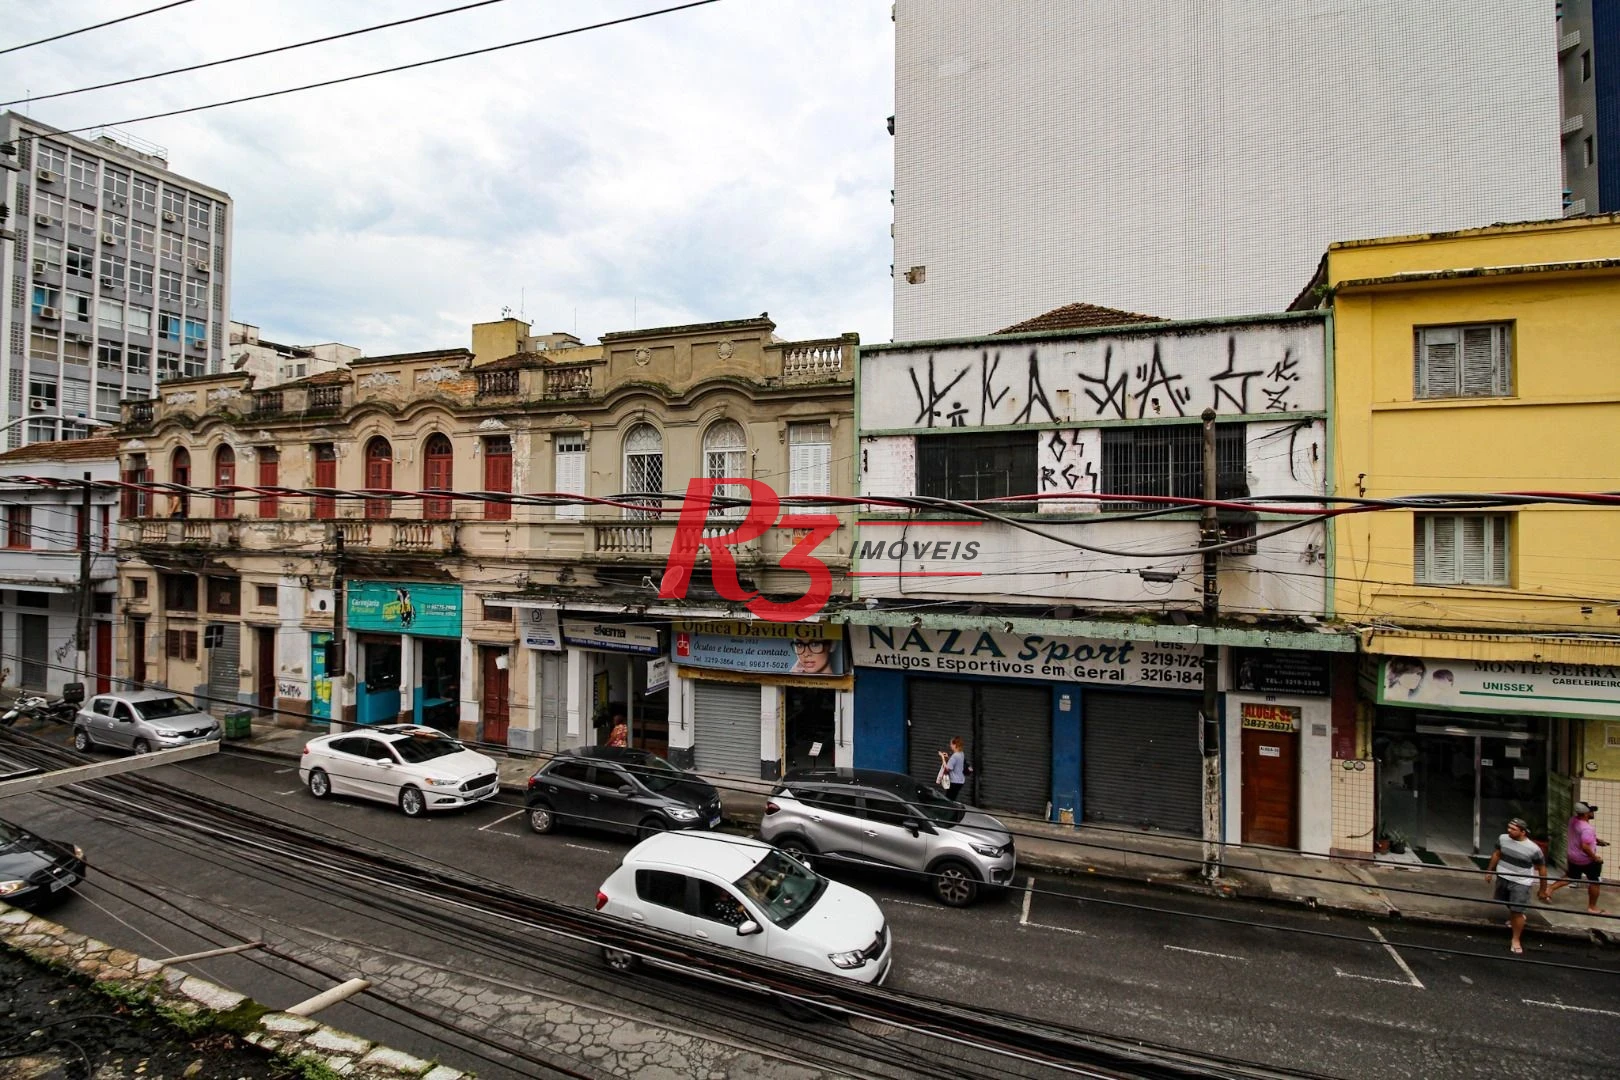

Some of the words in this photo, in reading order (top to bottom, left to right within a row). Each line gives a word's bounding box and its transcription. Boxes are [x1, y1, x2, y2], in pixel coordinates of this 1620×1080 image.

[737, 621, 787, 638] David
[794, 624, 824, 639] Gil
[723, 645, 744, 655] lentes
[867, 625, 1007, 658] NAZA
[874, 653, 931, 669] Artigos
[936, 656, 1035, 673] Esportivos
[1041, 665, 1065, 677] em
[1074, 665, 1125, 681] Geral
[1141, 668, 1203, 684] 3216-184
[1473, 661, 1543, 675] MONTE
[1549, 664, 1620, 679] SERRA
[1482, 681, 1534, 693] UNISSEX
